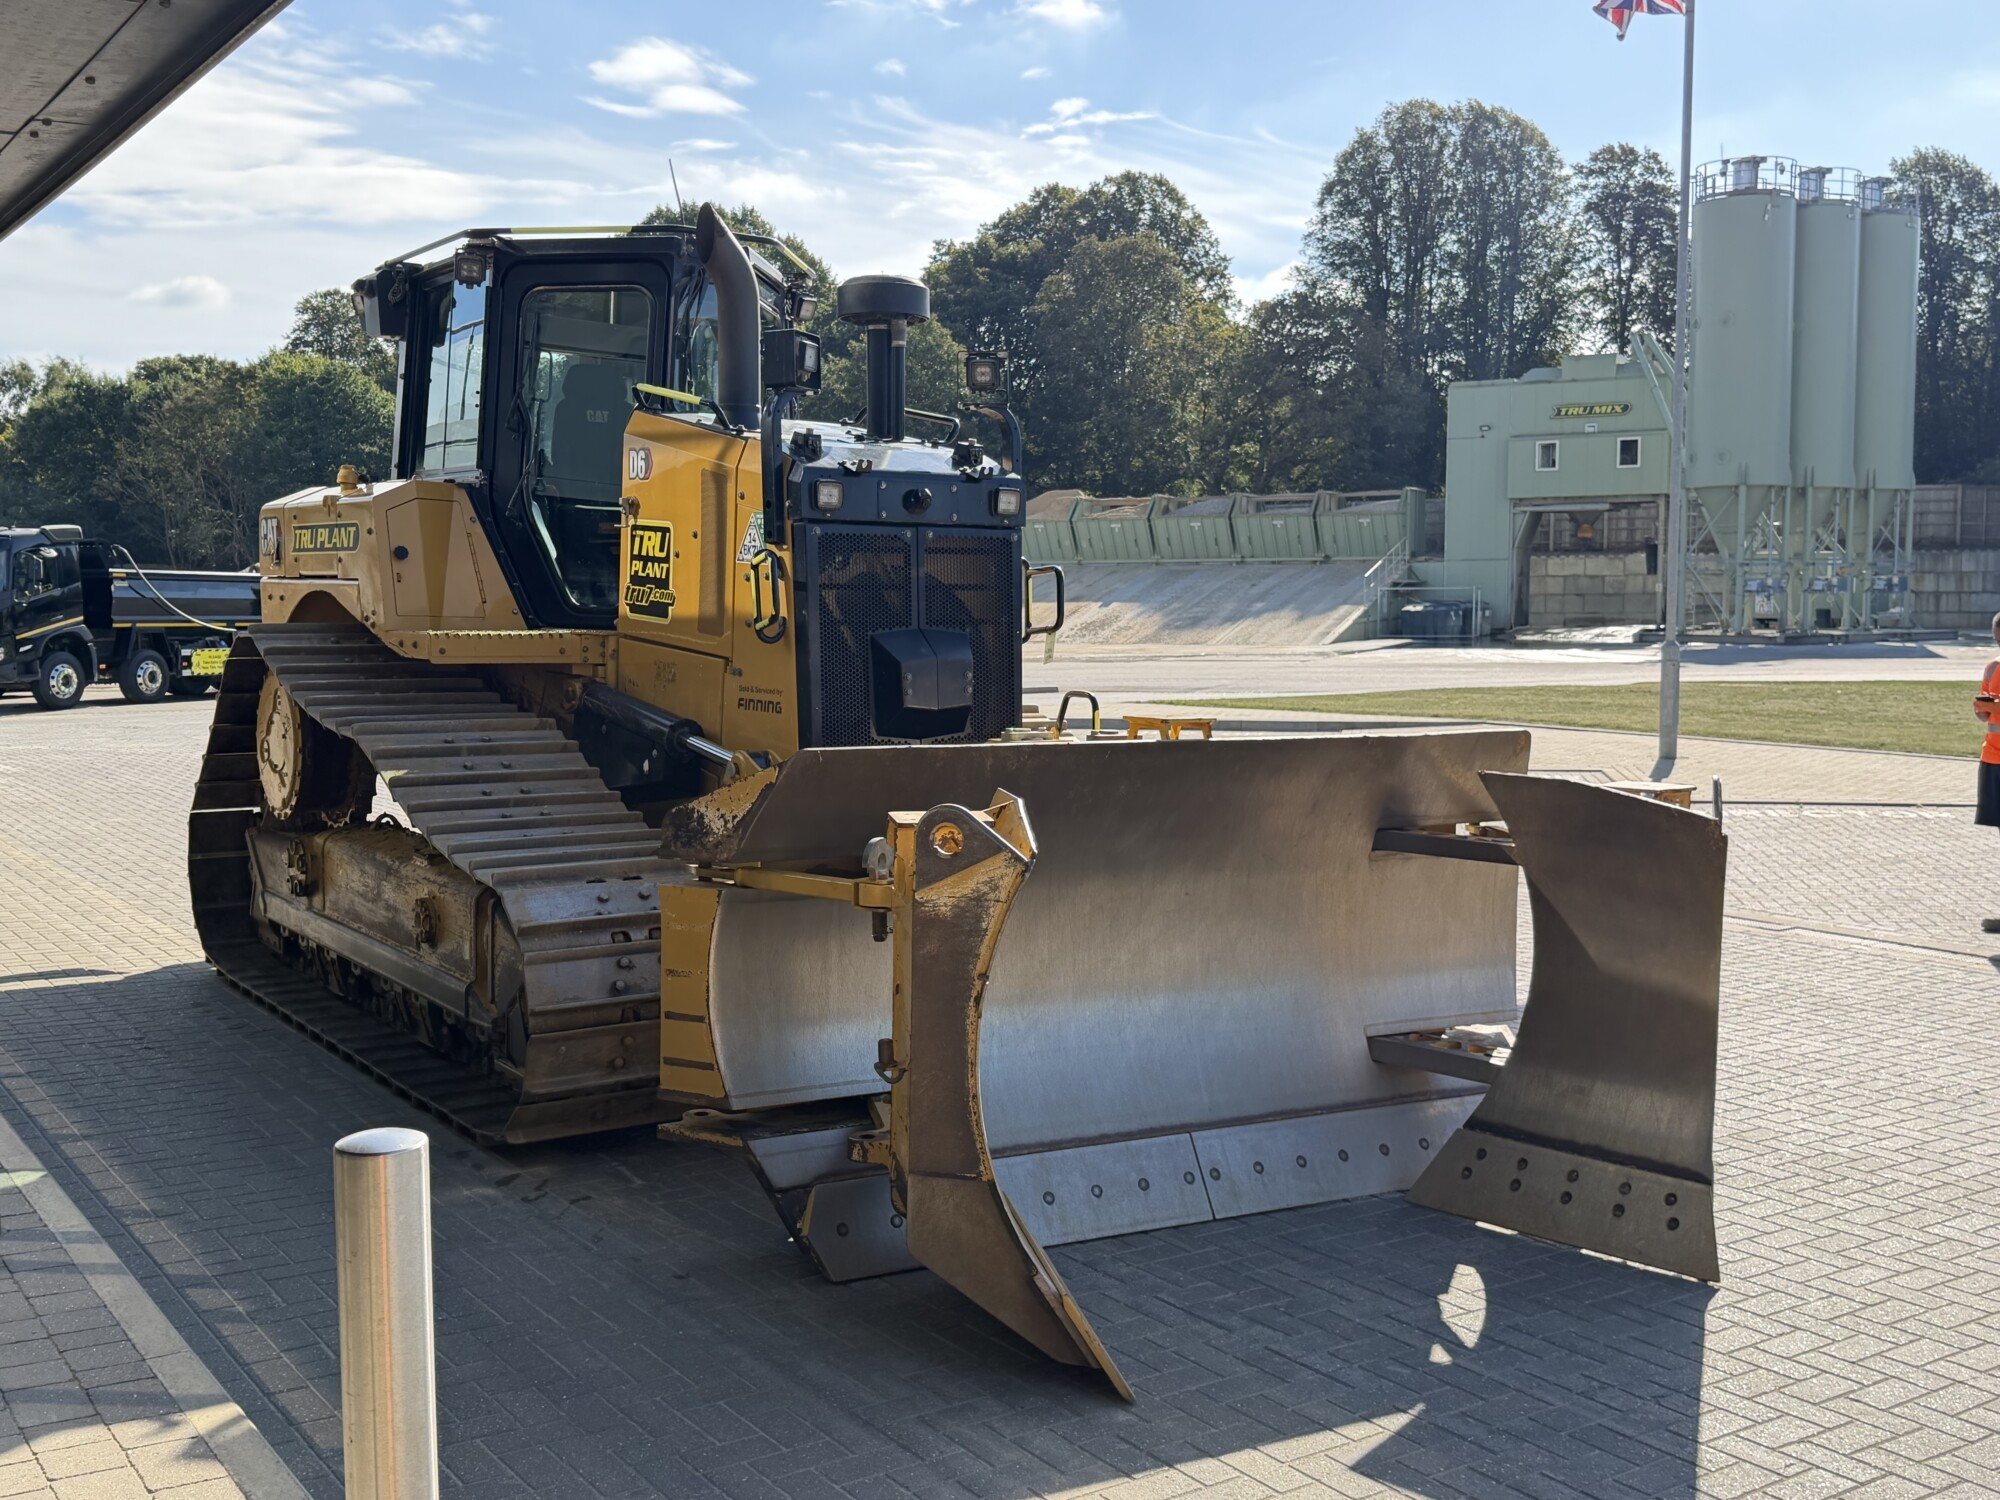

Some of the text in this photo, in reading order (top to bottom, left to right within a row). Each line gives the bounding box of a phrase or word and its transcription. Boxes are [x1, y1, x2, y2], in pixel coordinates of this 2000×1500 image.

[586, 409, 609, 423] CAT
[1559, 404, 1625, 416] TRU MIX
[629, 449, 646, 480] D6
[261, 518, 278, 556] CAT
[295, 526, 356, 549] TRU PLANT
[632, 530, 670, 558] TRU
[631, 561, 669, 580] PLANT
[624, 583, 676, 607] tru7.com
[755, 686, 776, 695] Serviced
[738, 698, 783, 714] FINNING
